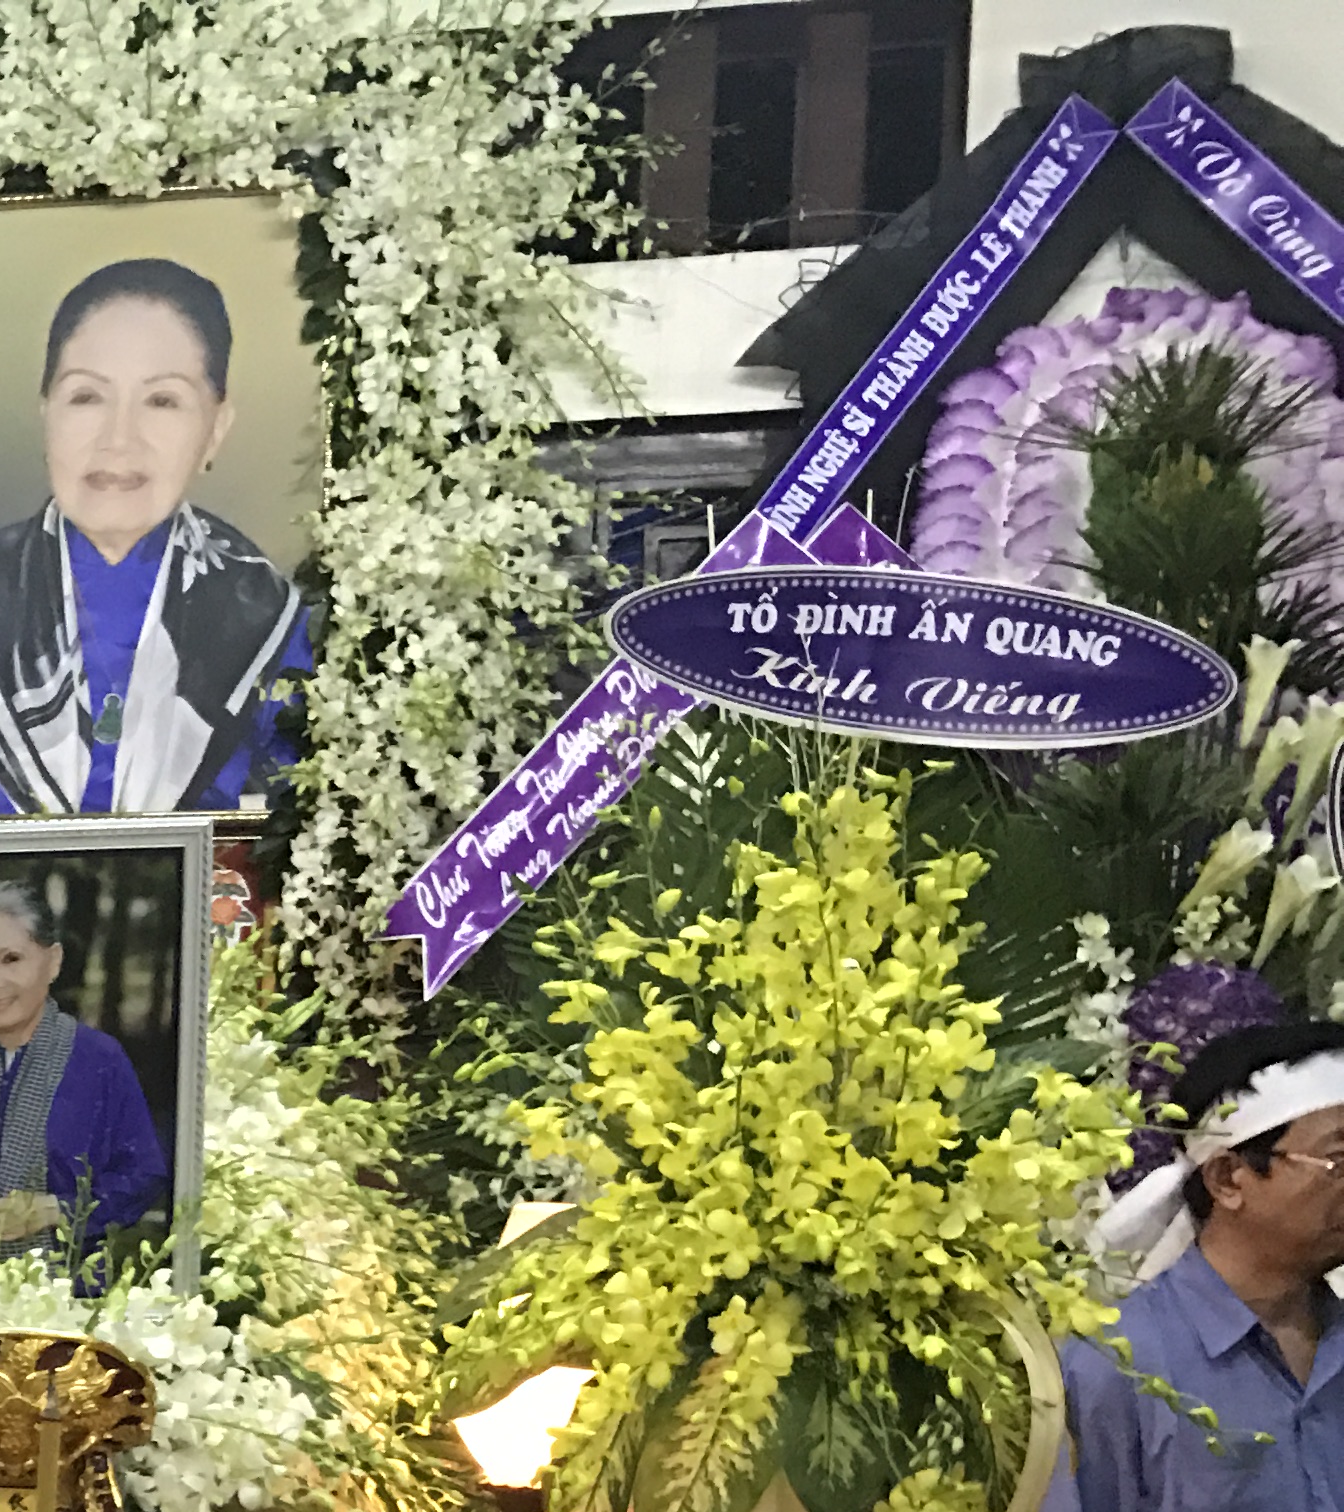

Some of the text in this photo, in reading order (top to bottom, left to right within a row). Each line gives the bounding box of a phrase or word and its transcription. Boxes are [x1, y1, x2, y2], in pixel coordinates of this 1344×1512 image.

[809, 428, 858, 495] NGHỆ
[841, 401, 875, 438] SĨ
[862, 329, 934, 412] THÀNH
[999, 157, 1068, 240] THANH
[727, 586, 1124, 668] TỔ ĐÌNH ẤN QUANG
[905, 676, 1085, 723] Viếng
[500, 849, 553, 909] Lng
